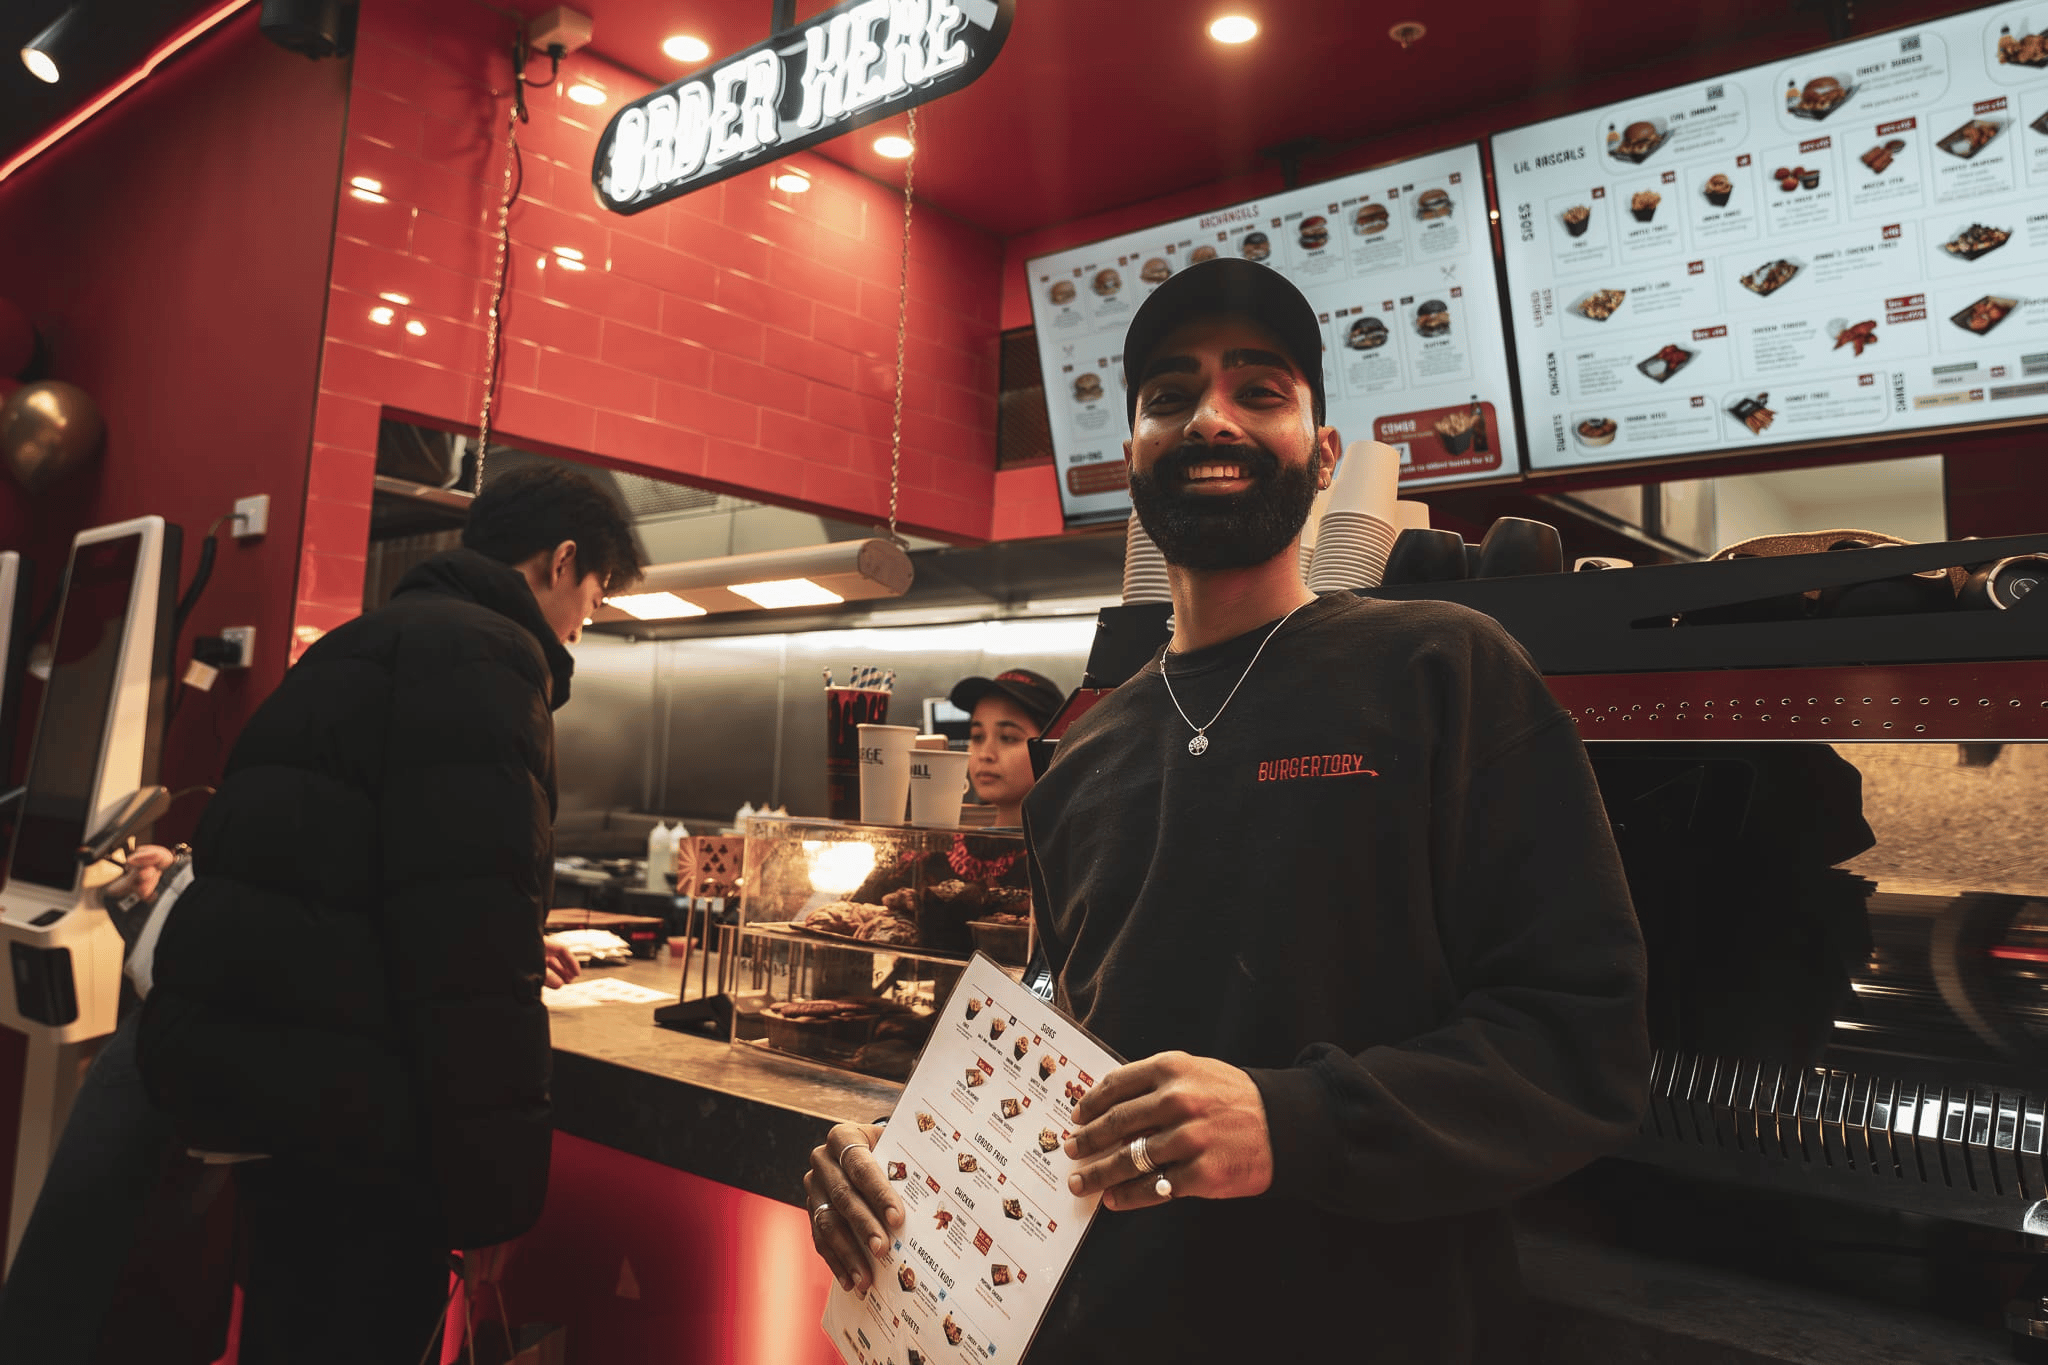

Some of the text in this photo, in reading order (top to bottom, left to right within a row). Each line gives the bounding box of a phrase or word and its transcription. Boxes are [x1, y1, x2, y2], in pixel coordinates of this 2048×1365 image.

[611, 0, 971, 202] ORDER HERE
[1534, 145, 1585, 169] RASCALS
[1518, 202, 1534, 242] SIDES
[1545, 351, 1559, 396] CHICKEN
[1379, 419, 1417, 435] COMBO
[1257, 753, 1380, 781] BURGERTORY
[1041, 1023, 1056, 1040] SIDES
[975, 1132, 993, 1154] LOADED
[994, 1149, 1008, 1167] FRIES
[955, 1186, 975, 1211] CHICKEN
[908, 1236, 955, 1290] LIL RASCALS (KIDS)
[901, 1308, 920, 1335] SWEETS
